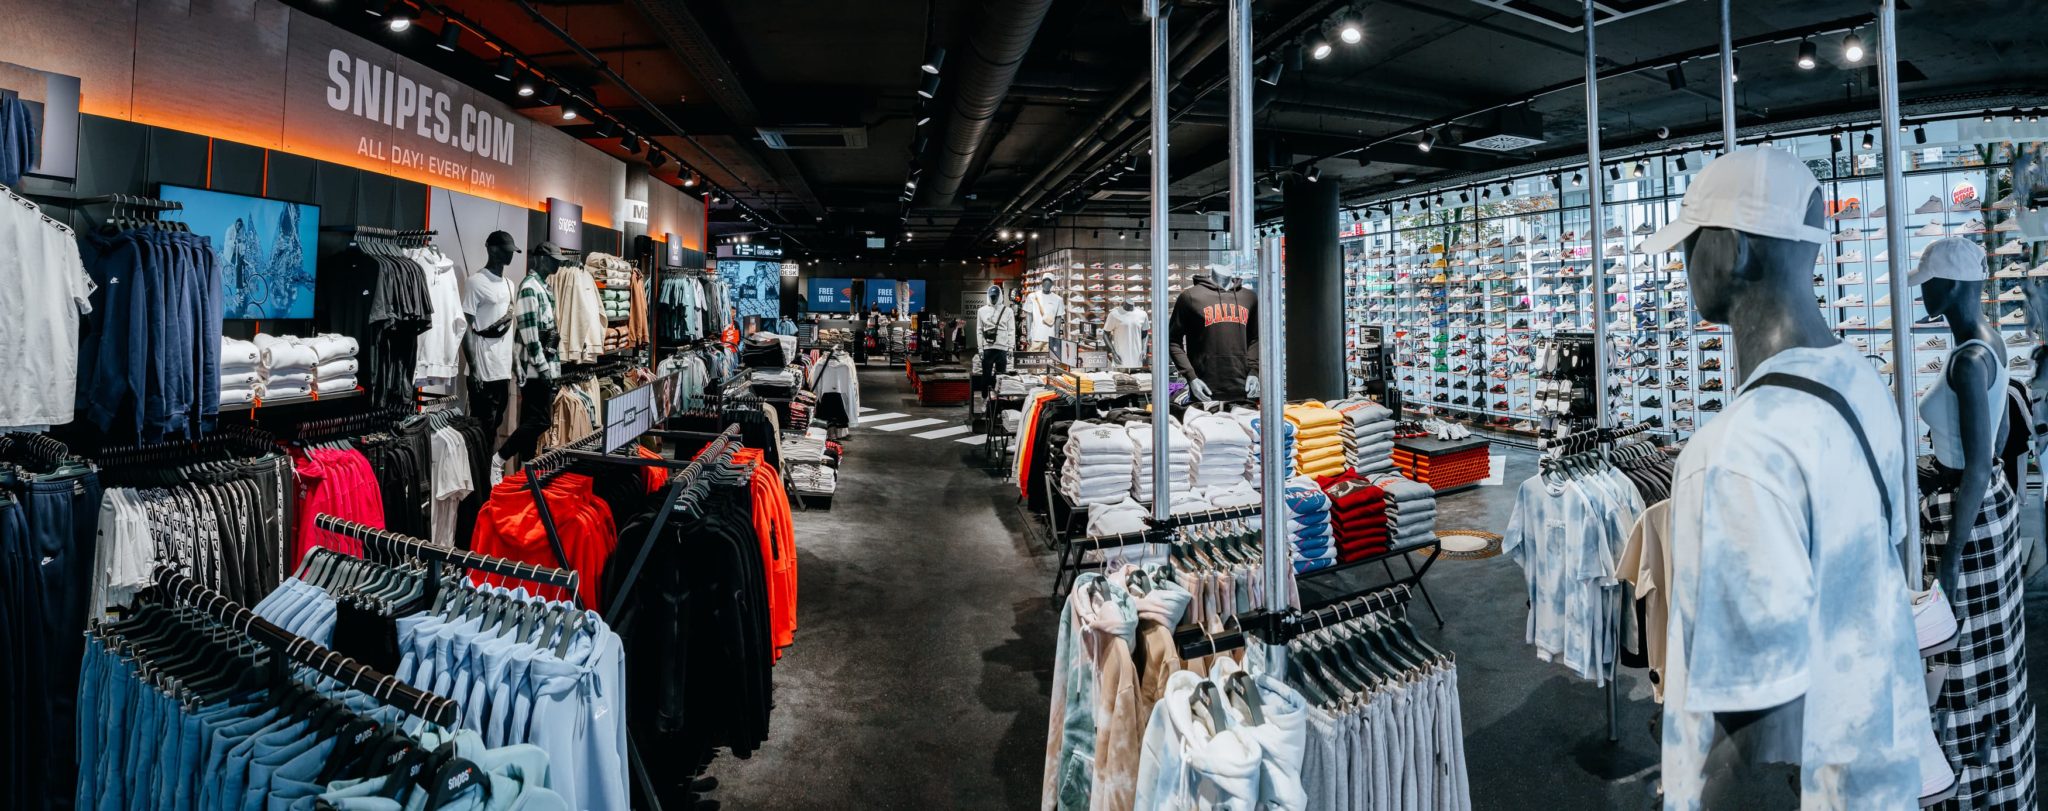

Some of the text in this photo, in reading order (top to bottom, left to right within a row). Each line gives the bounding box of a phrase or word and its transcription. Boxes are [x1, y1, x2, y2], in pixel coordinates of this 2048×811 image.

[326, 48, 515, 166] SNIPES.COM
[357, 136, 495, 189] ALL DAY! EVERY DAY!
[1953, 185, 1974, 199] BURGER
[1954, 191, 1975, 204] KING
[818, 287, 834, 295] FREE
[877, 288, 893, 296] FREE
[818, 295, 834, 303] WIFI
[877, 296, 893, 304] WIFI
[1284, 490, 1320, 505] NASA
[448, 770, 470, 790] snipes
